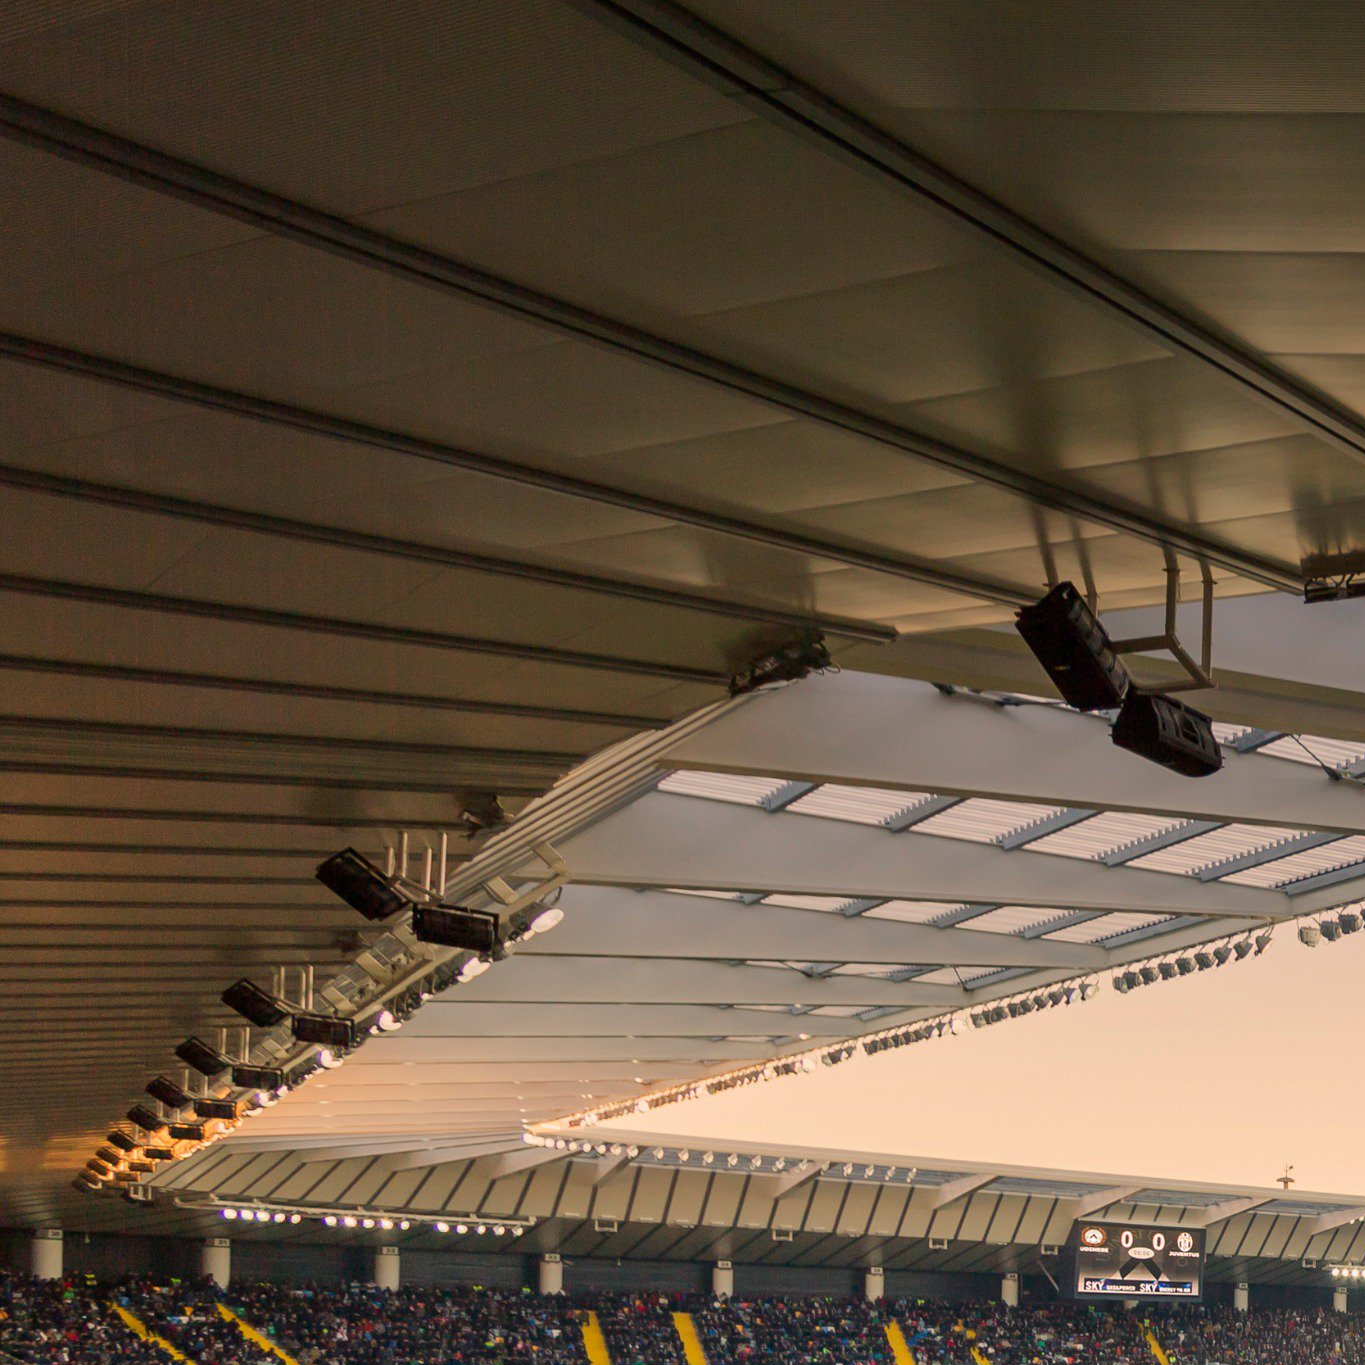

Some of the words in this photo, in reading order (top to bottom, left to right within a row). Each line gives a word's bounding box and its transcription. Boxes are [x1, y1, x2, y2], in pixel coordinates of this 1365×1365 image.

[1120, 1231, 1133, 1248] 0
[1152, 1232, 1165, 1250] 0
[1085, 1281, 1105, 1291] SKY
[1140, 1283, 1158, 1292] SKY
